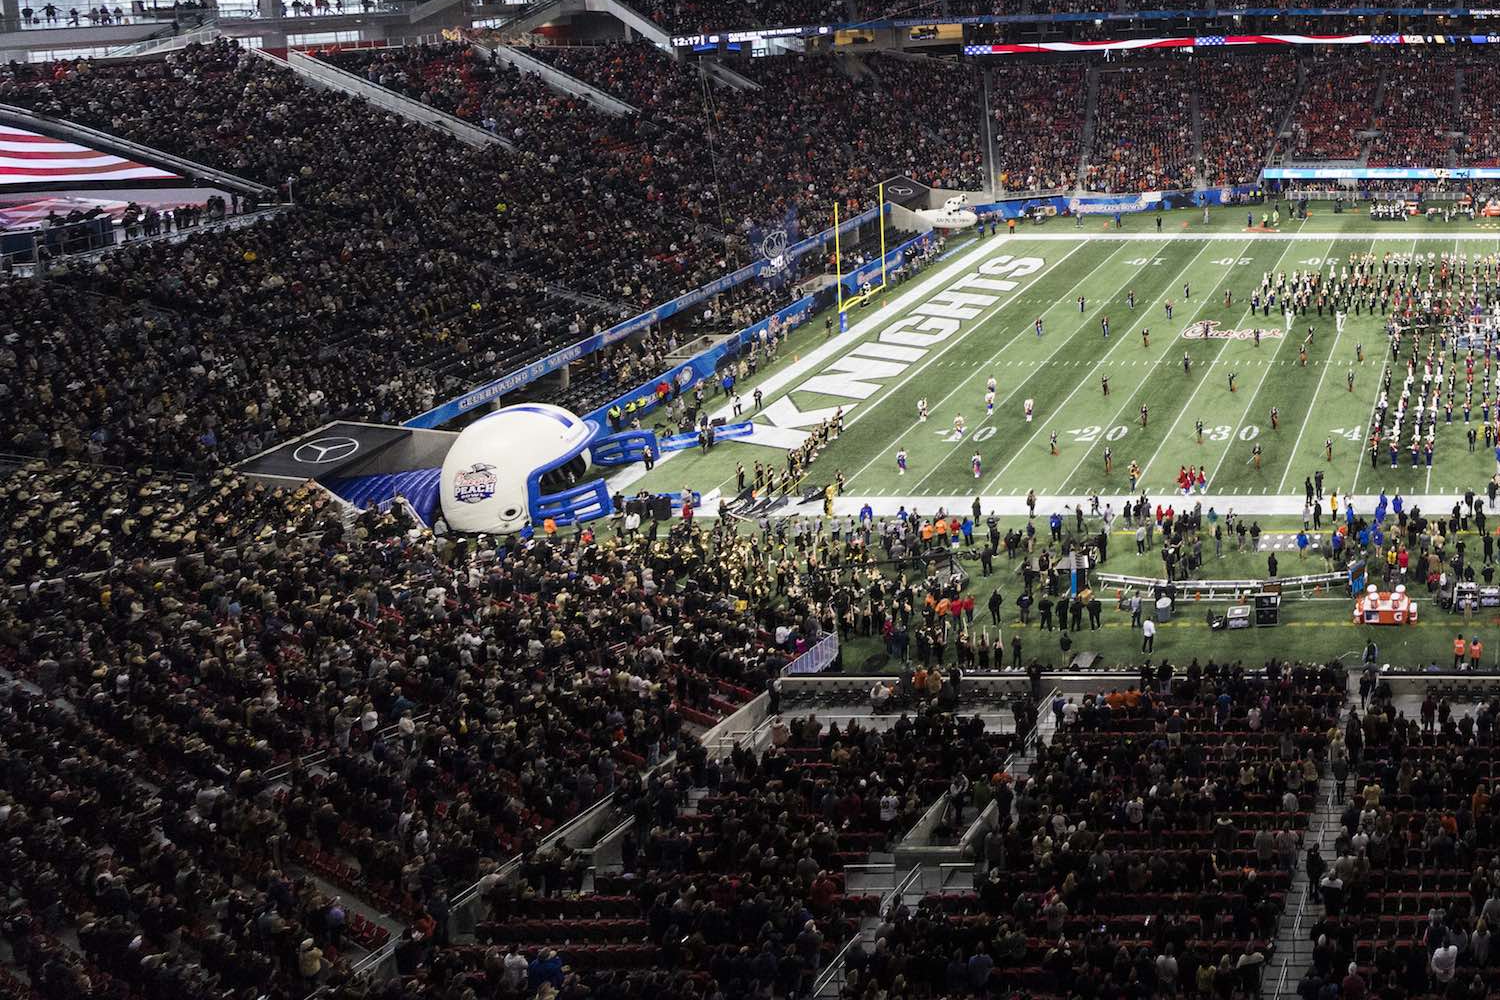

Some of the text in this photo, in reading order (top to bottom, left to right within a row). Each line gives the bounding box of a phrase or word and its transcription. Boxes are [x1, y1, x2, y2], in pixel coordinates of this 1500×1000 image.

[673, 36, 700, 47] 12:17
[728, 255, 1046, 450] KNIGHTS
[458, 370, 529, 409] CELEBRATING
[549, 346, 582, 366] YEARS
[1072, 425, 1129, 442] 20
[1209, 425, 1260, 442] 30
[455, 484, 495, 496] PEACH
[1394, 612, 1402, 621] G
